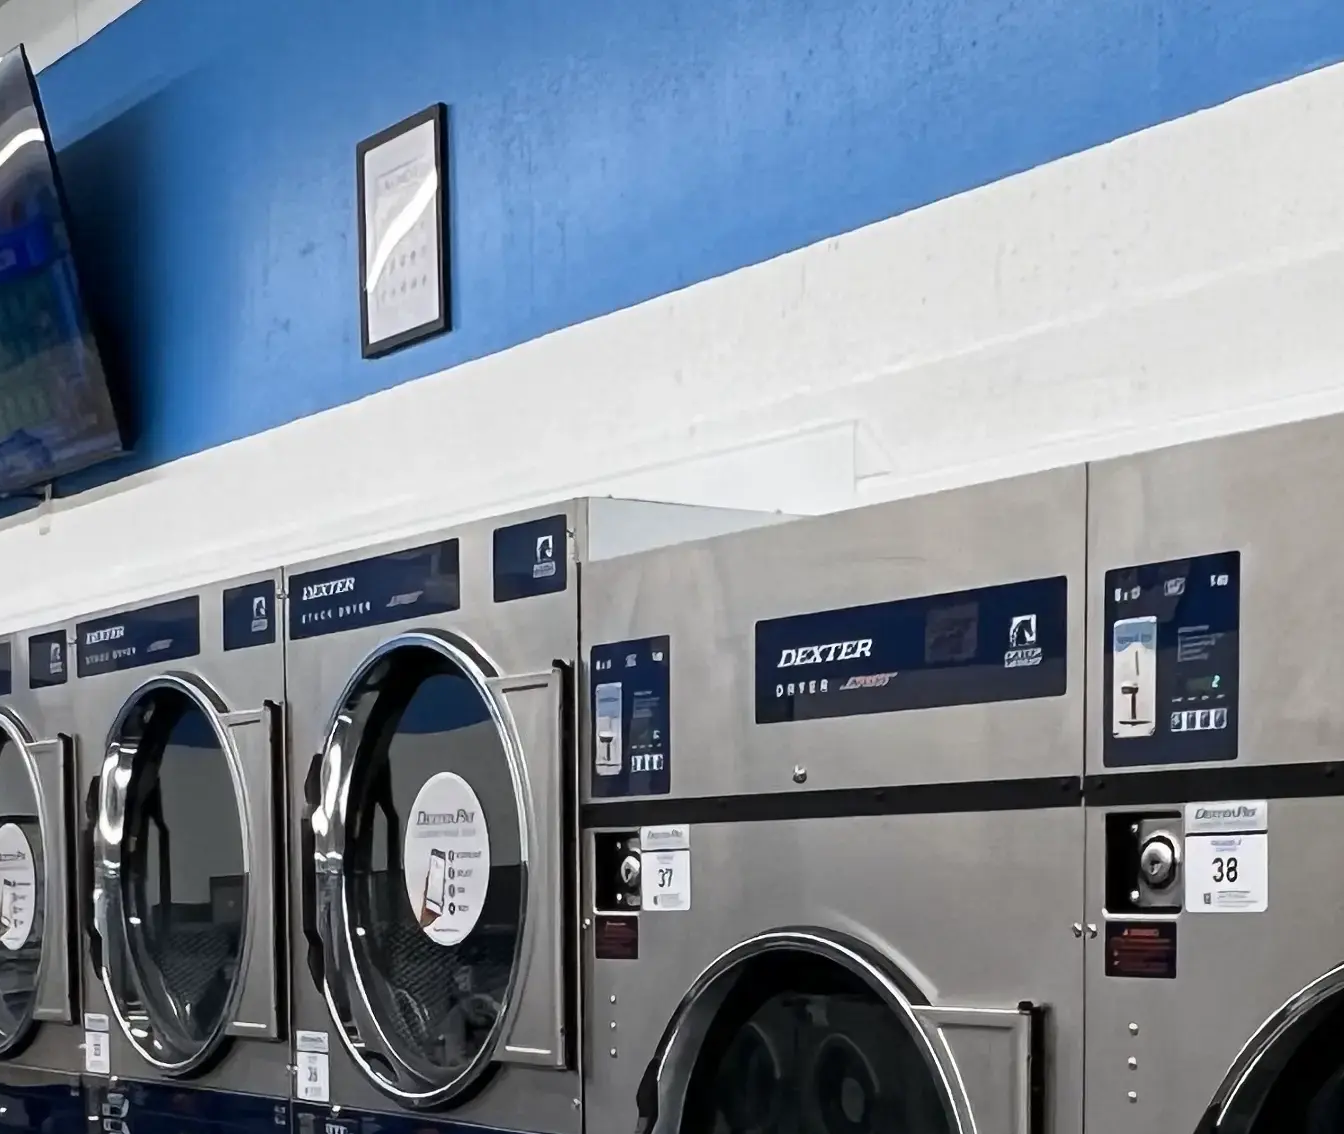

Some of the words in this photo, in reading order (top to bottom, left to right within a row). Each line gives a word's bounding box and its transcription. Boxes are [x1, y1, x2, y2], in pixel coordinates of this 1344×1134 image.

[302, 577, 355, 601] DEXTER
[777, 639, 873, 668] DEXTER
[775, 679, 828, 698] DRYER
[658, 868, 673, 888] 37
[1212, 857, 1239, 883] 38
